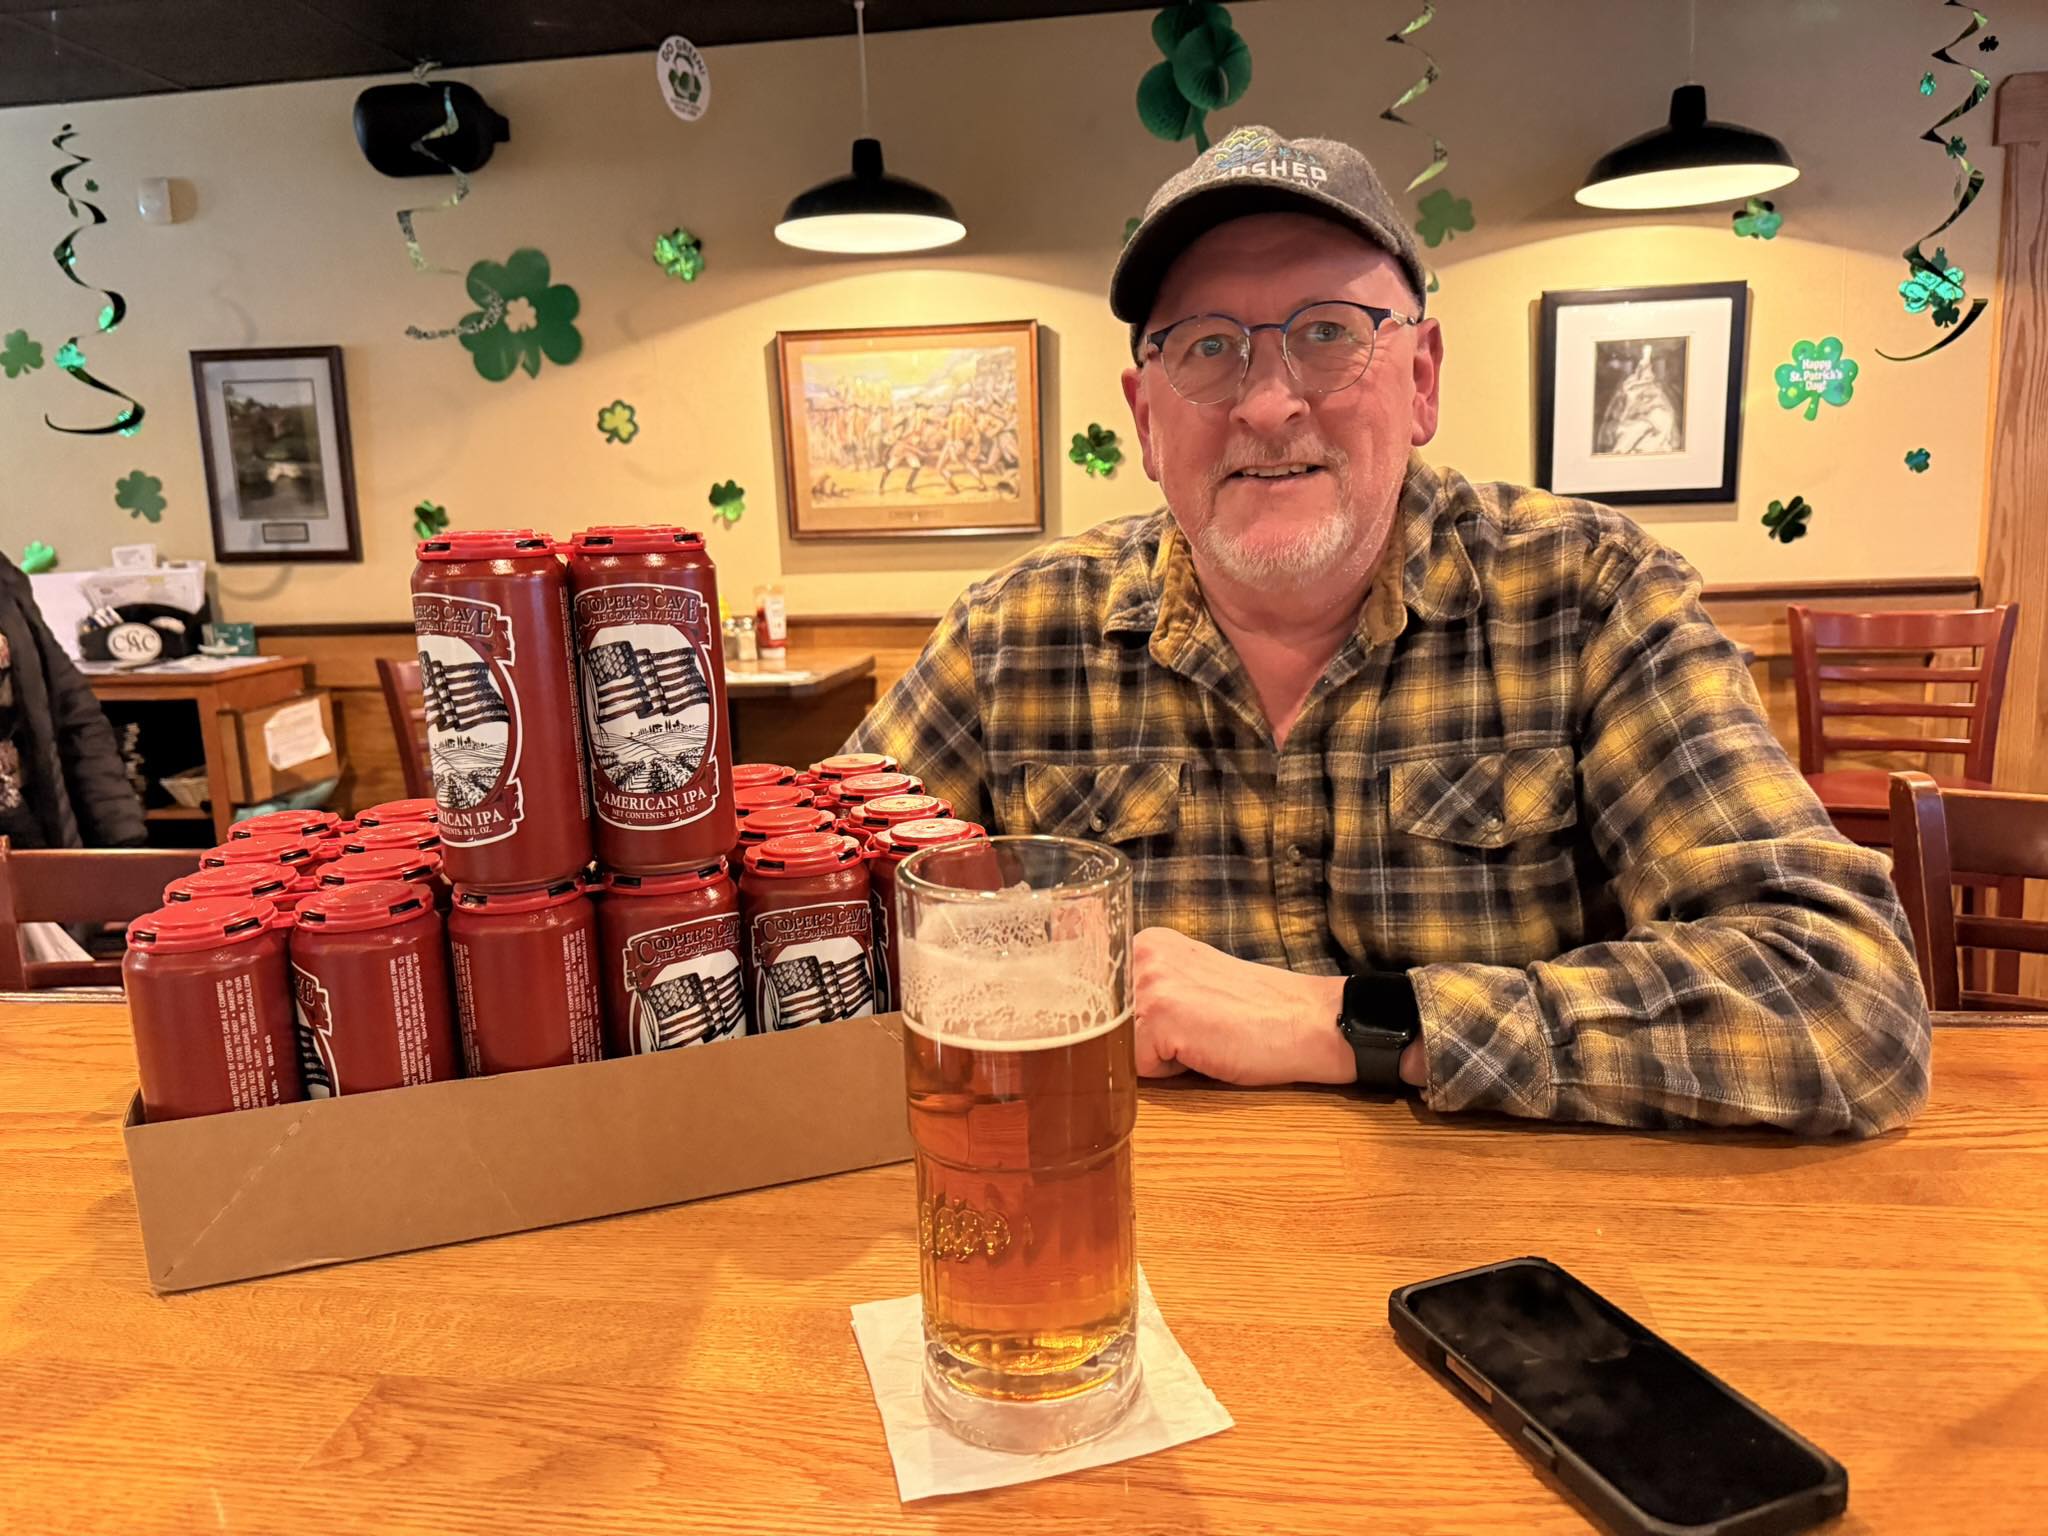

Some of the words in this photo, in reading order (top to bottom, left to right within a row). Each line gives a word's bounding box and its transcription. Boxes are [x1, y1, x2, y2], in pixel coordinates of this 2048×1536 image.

[661, 42, 674, 63] GO
[1802, 359, 1832, 372] Happy
[1804, 368, 1843, 382] Patrick's
[580, 594, 650, 627] COOPER'S
[654, 594, 700, 624] CAVE
[443, 606, 494, 637] CAVE
[602, 791, 680, 811] AMERICAN
[683, 786, 707, 805] IPA
[475, 808, 505, 826] IPA
[612, 808, 624, 818] NET
[625, 811, 666, 820] CONTENTS:
[675, 808, 686, 816] FL.
[686, 804, 699, 813] OZ.
[224, 979, 232, 987] OF
[233, 975, 242, 992] YOUR
[236, 992, 244, 1004] FOR
[223, 1034, 233, 1061] COOPER'S
[229, 1070, 239, 1094] BOTTLED
